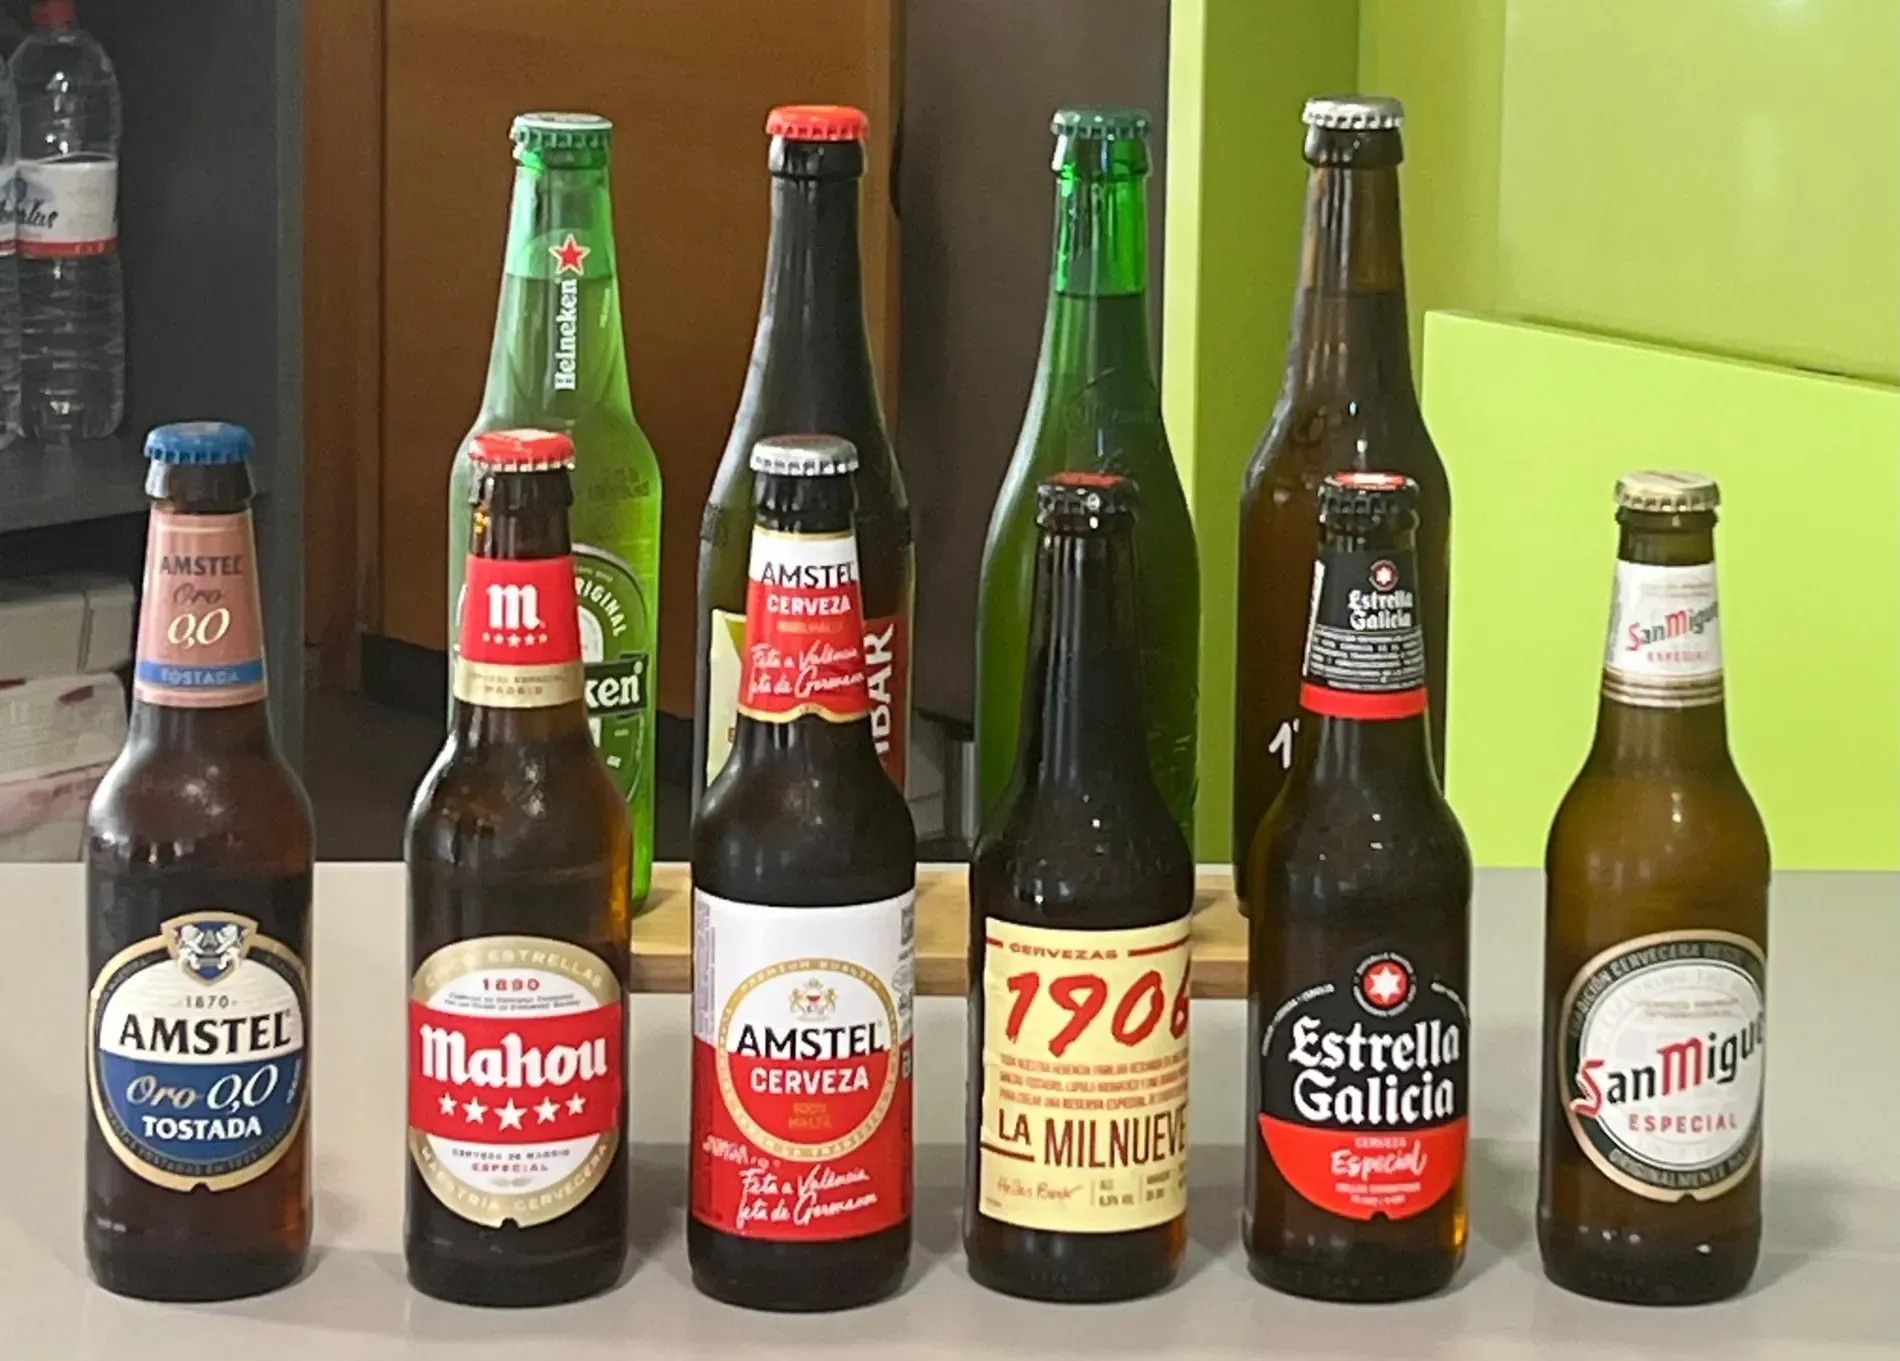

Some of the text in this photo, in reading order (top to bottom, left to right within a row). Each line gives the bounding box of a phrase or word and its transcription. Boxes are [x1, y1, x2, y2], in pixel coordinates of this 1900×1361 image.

[554, 279, 577, 391] Heineken
[159, 556, 243, 575] AMSTEL
[760, 561, 855, 588] AMSTEL
[173, 582, 223, 604] Oro
[575, 576, 627, 637] RIGINAL
[766, 594, 852, 615] CERVEZA
[1349, 589, 1413, 611] Estrella
[168, 607, 231, 649] 0,0
[1350, 608, 1412, 630] Galicia
[161, 668, 240, 685] TOSTADA
[1008, 942, 1119, 960] CERVEZAS
[186, 995, 230, 1009] 1870
[1005, 959, 1190, 1058] 1906
[118, 1009, 291, 1056] AMSTEL
[736, 1022, 885, 1061] AMSTEL
[1287, 1015, 1460, 1072] Estrella
[126, 1075, 197, 1109] Oro
[206, 1063, 279, 1114] 0,0
[751, 1065, 869, 1094] CERVEZA
[1293, 1068, 1455, 1125] Galicia
[142, 1115, 263, 1140] TOSTADA
[998, 1107, 1032, 1146] LA
[1628, 1112, 1738, 1134] ESPECIAL
[1330, 1140, 1428, 1181] Especial
